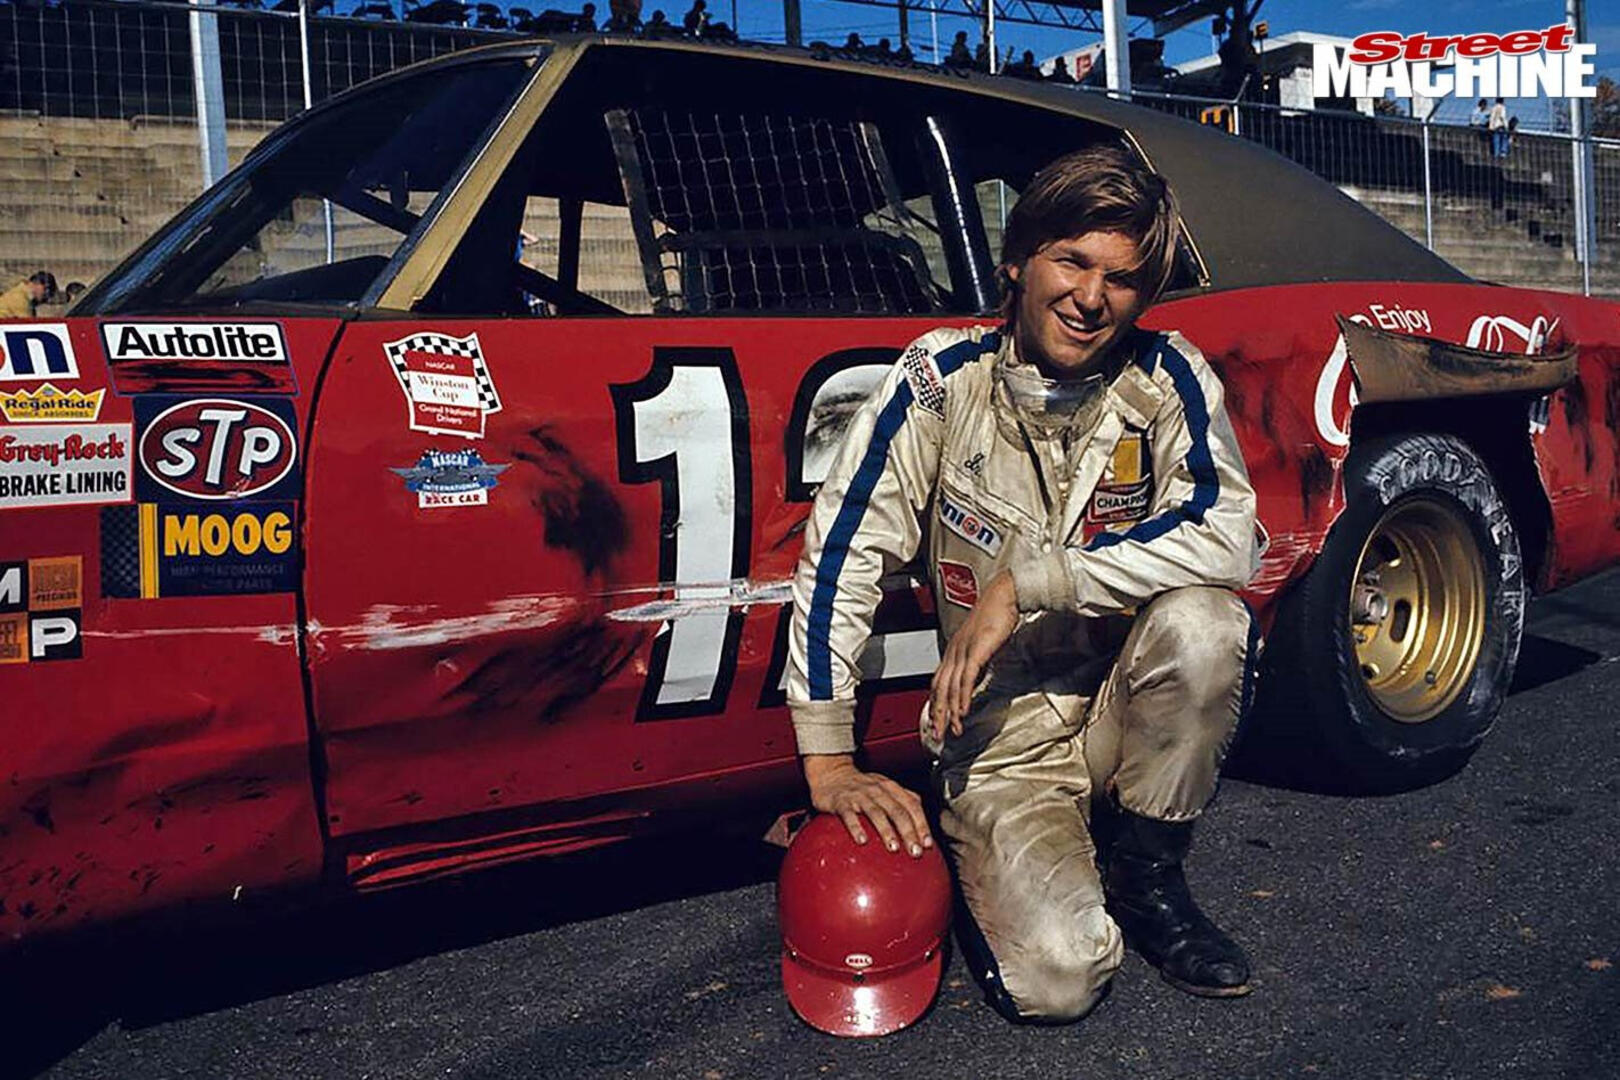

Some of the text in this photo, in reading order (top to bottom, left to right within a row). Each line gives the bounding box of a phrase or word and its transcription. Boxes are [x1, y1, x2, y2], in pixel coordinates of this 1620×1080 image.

[1370, 304, 1433, 334] Enjoy
[117, 326, 277, 358] Autolite
[417, 374, 469, 389] Winston
[432, 387, 459, 402] Cup
[5, 398, 95, 412] Regal Ride
[418, 403, 478, 418] Grand National
[436, 414, 463, 425] Drivers
[0, 432, 125, 466] Grey-Rock
[156, 409, 281, 485] STP
[431, 452, 469, 468] NASCAR
[0, 471, 126, 497] BRAKE LINING
[425, 494, 480, 504] RACE CAR
[164, 512, 292, 557] MOOG
